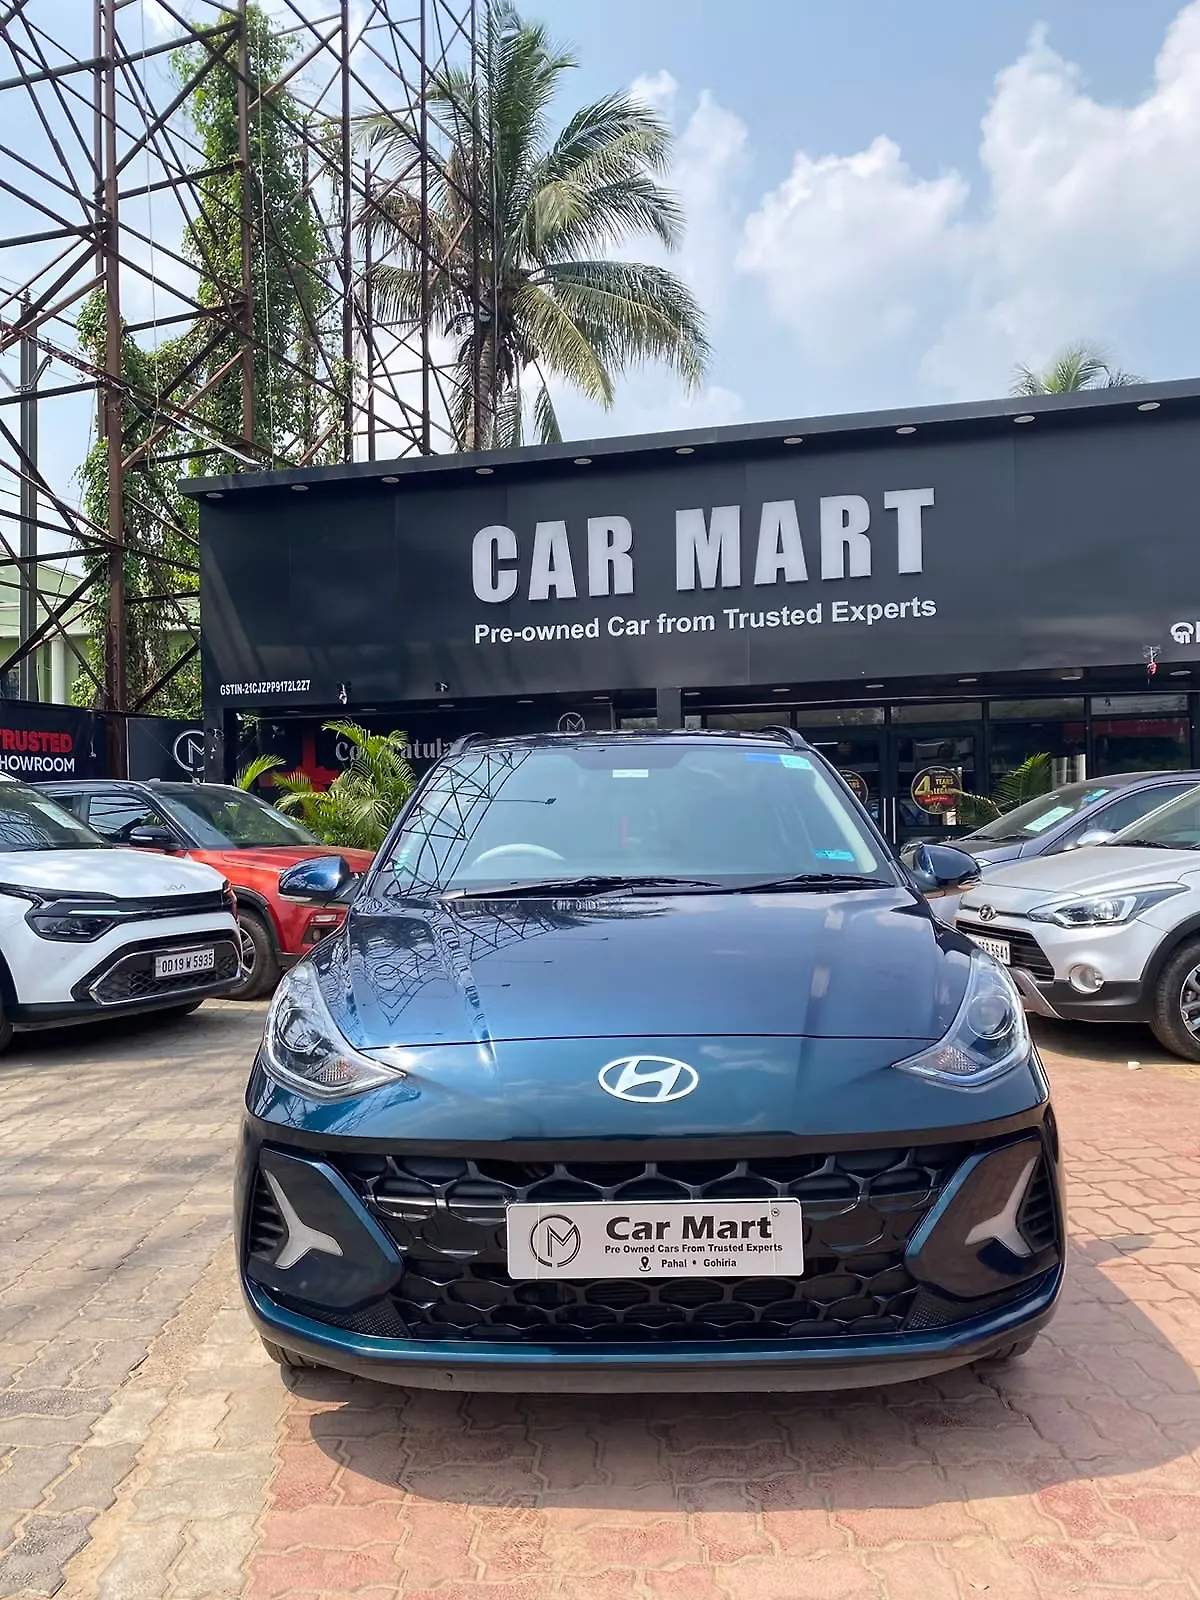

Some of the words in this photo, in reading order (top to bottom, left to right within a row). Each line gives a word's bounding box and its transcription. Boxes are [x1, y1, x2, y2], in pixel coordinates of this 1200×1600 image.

[472, 516, 636, 604] CAR
[675, 488, 935, 592] MART
[474, 618, 600, 644] Pre-owned
[607, 615, 650, 638] Car
[657, 612, 716, 634] from
[723, 603, 823, 630] Trusted
[832, 596, 937, 624] Experts
[0, 729, 72, 752] RUSTED
[162, 958, 184, 972] OD19
[194, 953, 213, 968] 5935
[606, 1216, 671, 1240] Car
[682, 1215, 773, 1240] Mart
[604, 1245, 621, 1254] Pre
[623, 1244, 656, 1254] Owned
[658, 1244, 680, 1253] Cars
[682, 1244, 706, 1252] From
[708, 1244, 744, 1252] Trusted
[746, 1244, 783, 1254] Experts
[661, 1258, 687, 1268] Pahal
[703, 1258, 737, 1268] Gohiria
